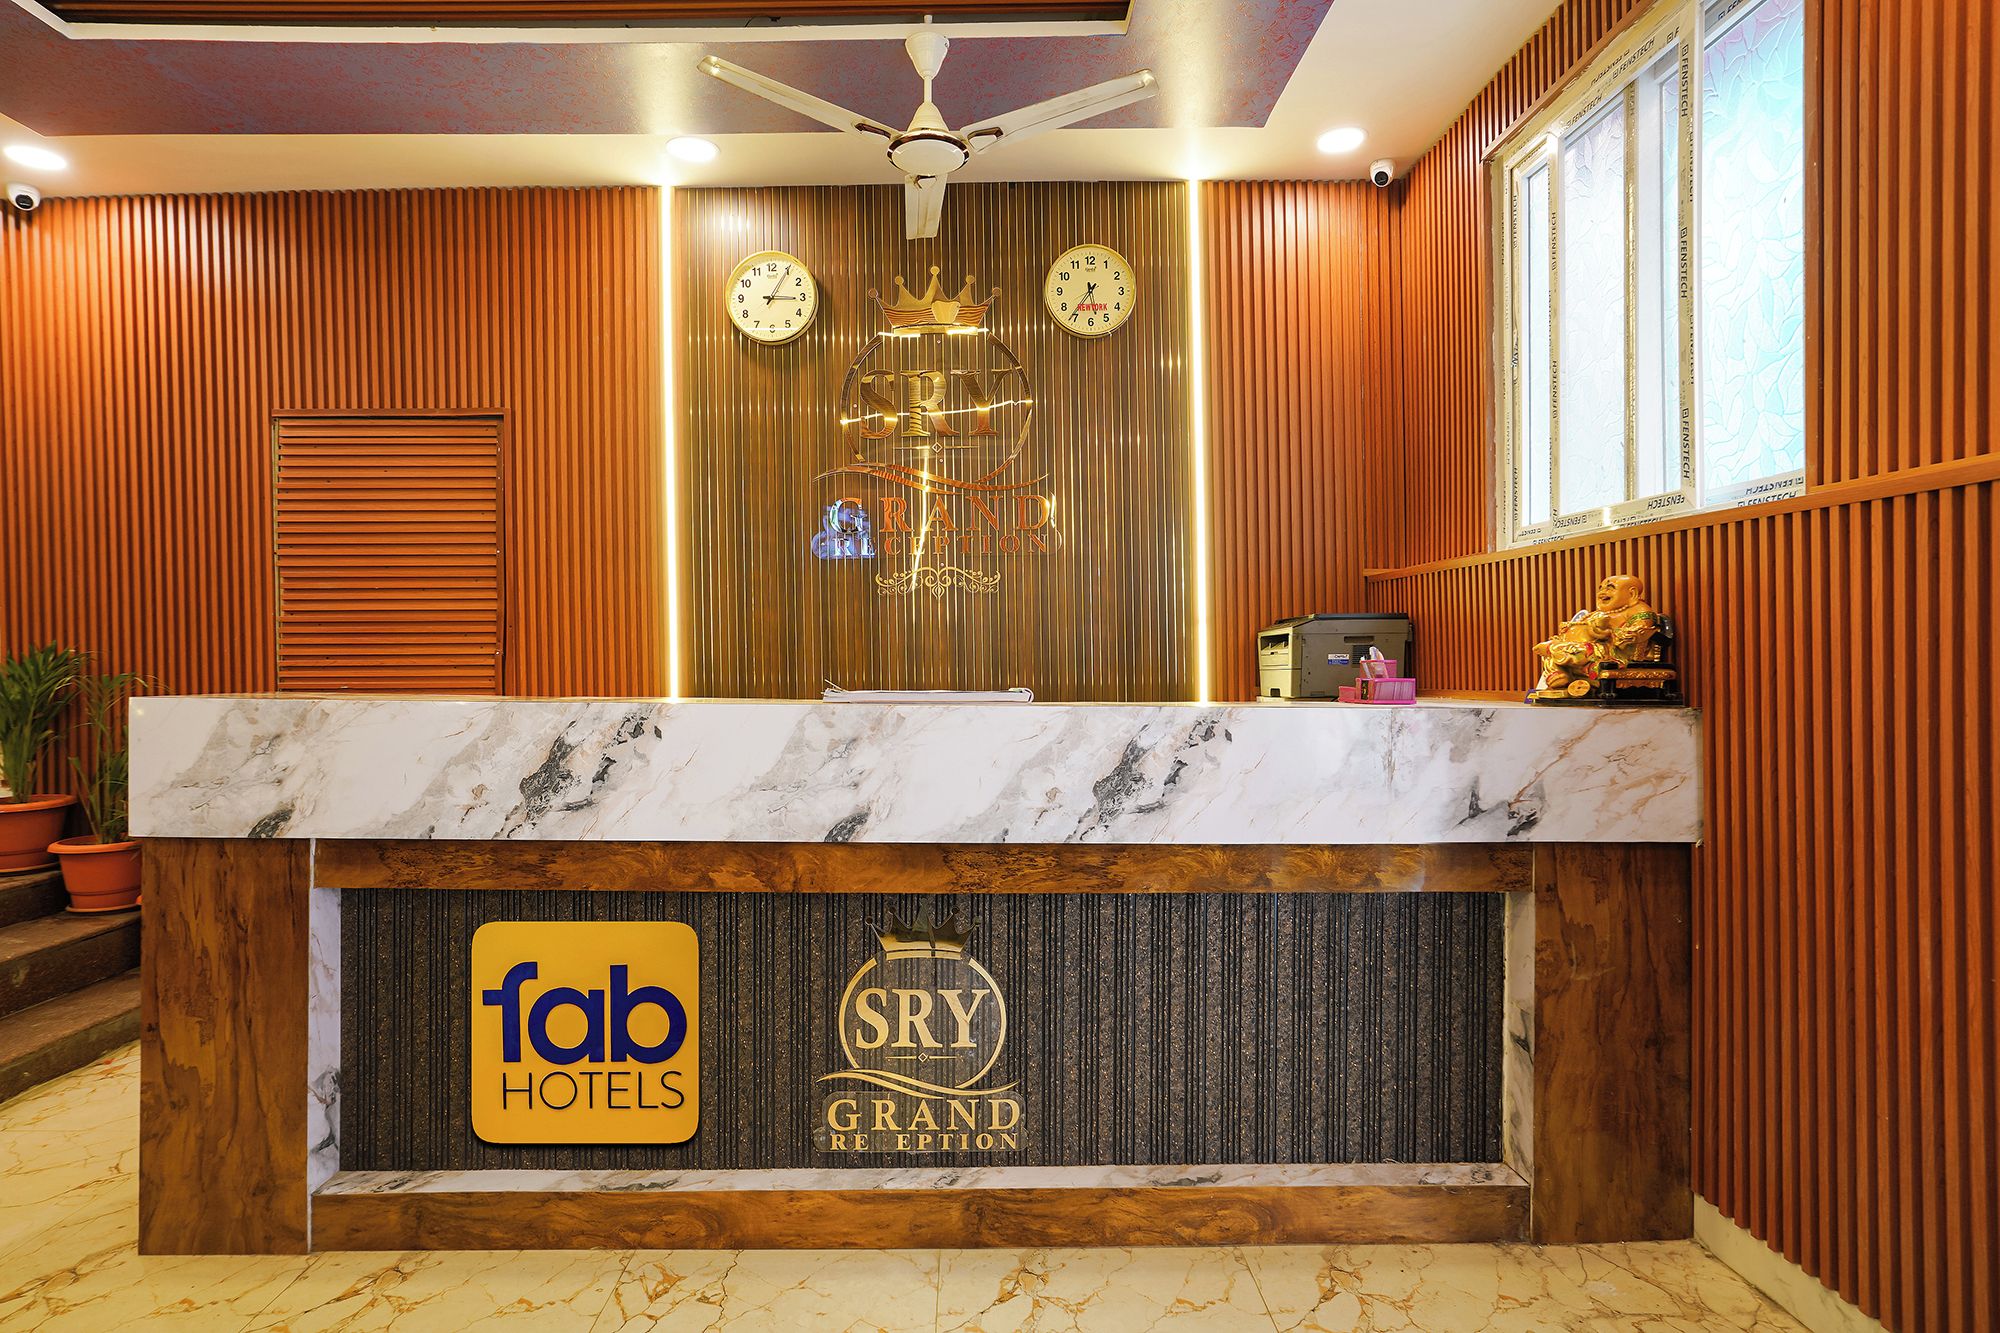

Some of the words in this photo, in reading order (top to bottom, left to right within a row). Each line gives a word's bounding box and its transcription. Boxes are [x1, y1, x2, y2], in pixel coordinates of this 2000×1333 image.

[1618, 37, 1655, 74] FENSTECH
[1681, 58, 1689, 117] FENSTECH
[1571, 93, 1603, 126] FENSTECH
[1070, 260, 1080, 270] 11
[1085, 255, 1096, 266] 12
[1103, 260, 1108, 269] 1
[752, 267, 761, 276] 11
[766, 262, 777, 272] 12
[1680, 240, 1688, 298] FENSTECH
[1058, 271, 1070, 281] 10
[1113, 271, 1120, 281] 2
[740, 278, 752, 288] 10
[795, 277, 802, 287] 2
[1056, 286, 1063, 296] 9
[1118, 286, 1125, 296] 3
[737, 294, 745, 303] 9
[799, 292, 807, 302] 3
[1060, 302, 1068, 311] 8
[1114, 302, 1121, 311] 4
[742, 309, 749, 319] 8
[795, 308, 803, 317] 4
[1071, 313, 1079, 323] 7
[1087, 317, 1094, 327] 6
[1103, 313, 1110, 323] 5
[753, 320, 761, 329] 7
[784, 319, 791, 329] 5
[860, 369, 1014, 440] SRY
[1682, 421, 1690, 479] FENSTECH
[1647, 494, 1685, 510] FENSTECH
[829, 495, 1051, 535] GRAND
[832, 534, 1048, 557] RECEPTION
[482, 961, 687, 1065] fab
[855, 988, 991, 1049] SRY
[503, 1071, 685, 1110] HOTELS
[827, 1098, 1021, 1132] GRAND
